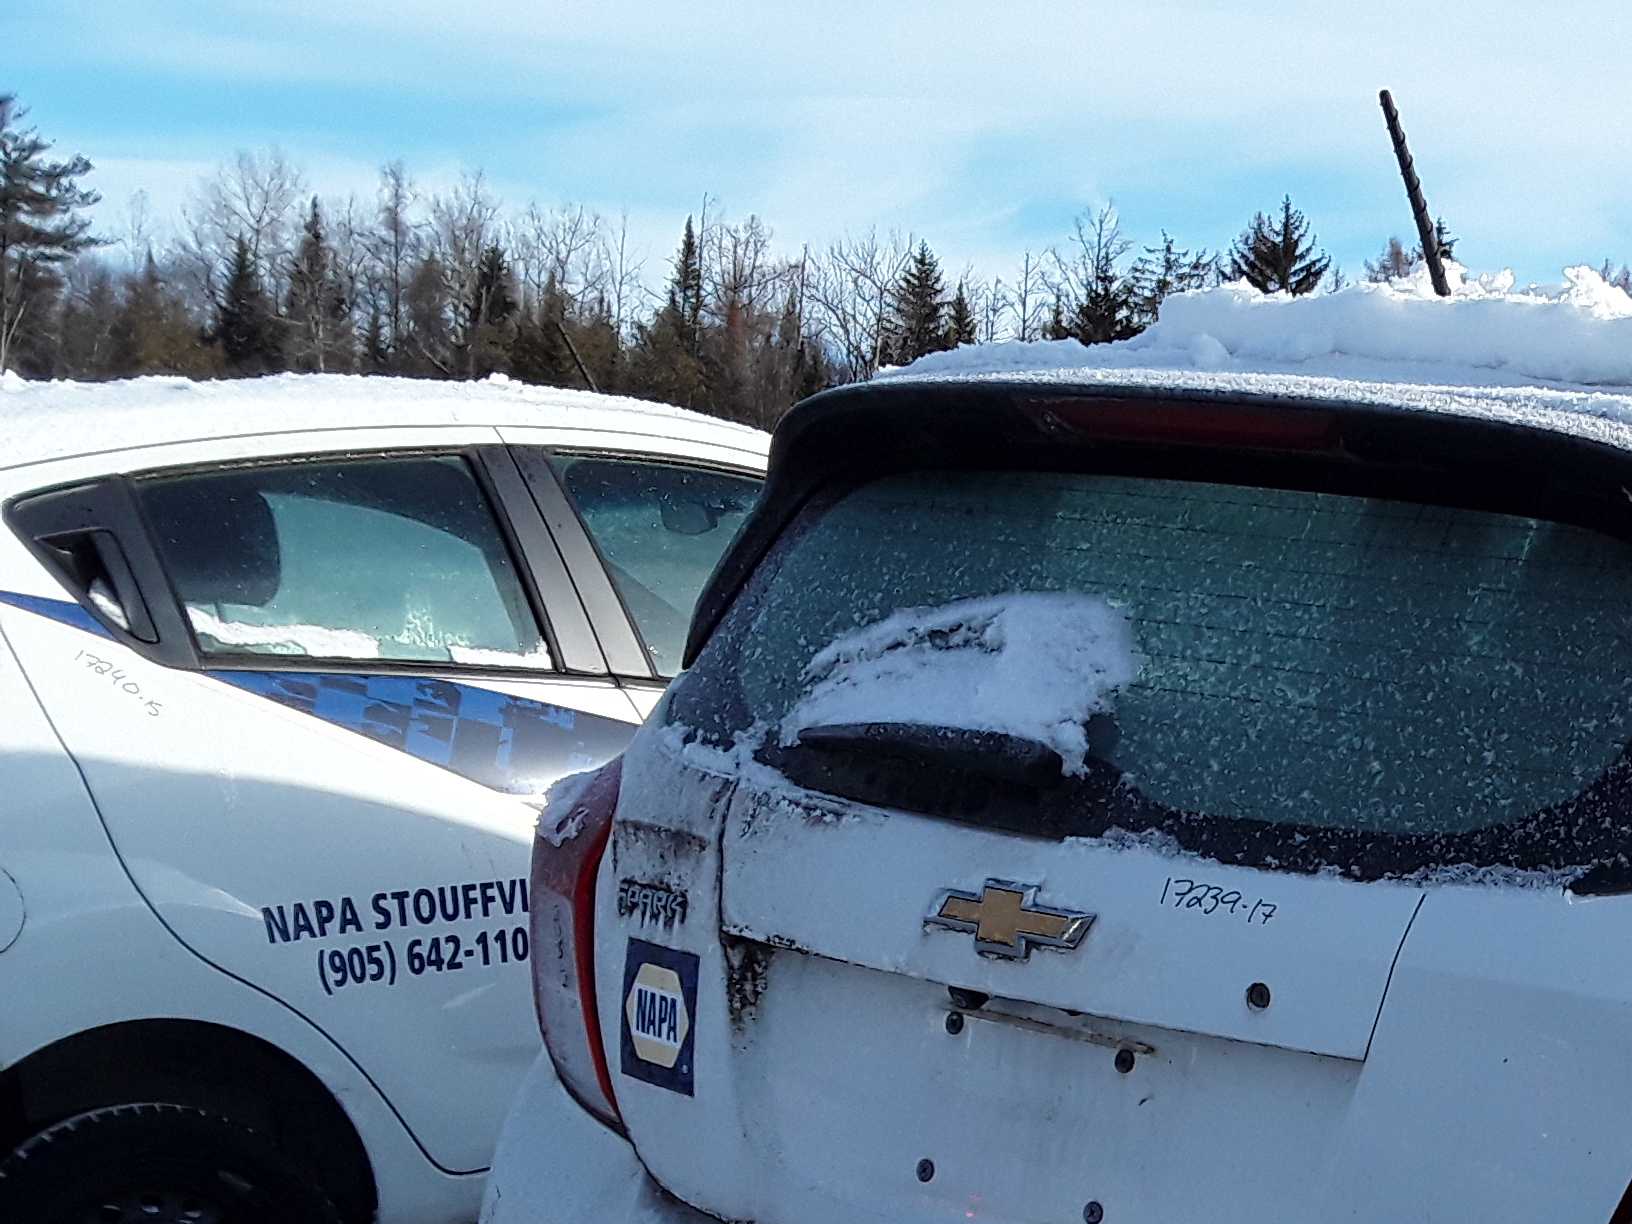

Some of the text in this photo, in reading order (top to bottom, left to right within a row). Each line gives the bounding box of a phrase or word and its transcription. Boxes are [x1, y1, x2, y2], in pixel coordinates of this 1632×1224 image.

[263, 897, 363, 943] NAPA
[318, 942, 396, 995] (905)
[636, 988, 678, 1044] NAPA
